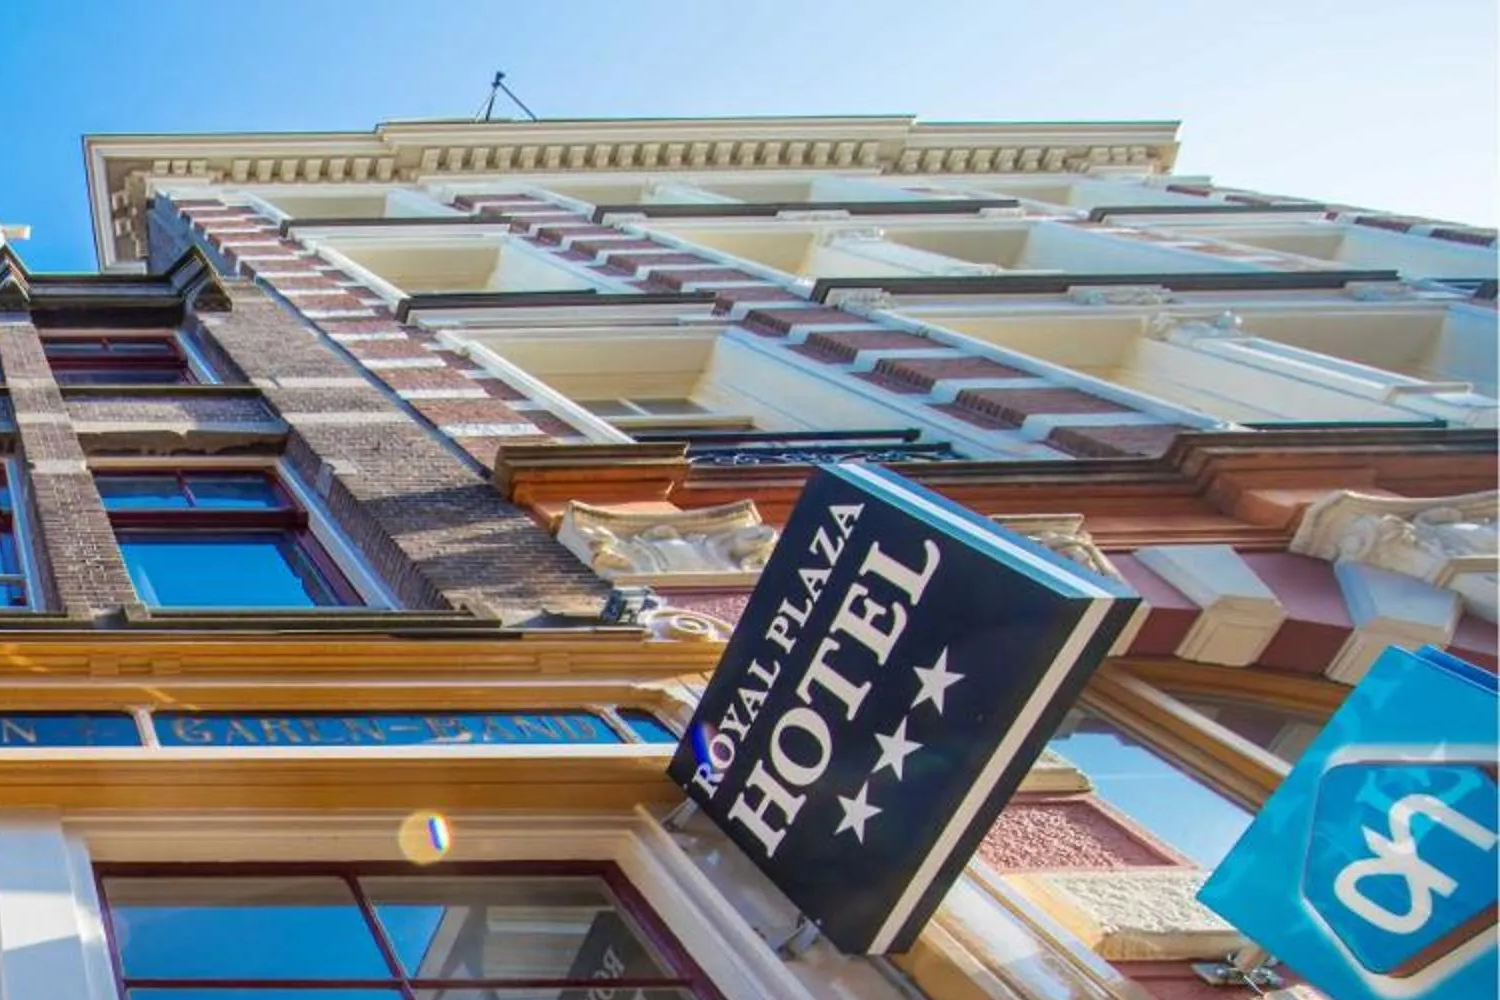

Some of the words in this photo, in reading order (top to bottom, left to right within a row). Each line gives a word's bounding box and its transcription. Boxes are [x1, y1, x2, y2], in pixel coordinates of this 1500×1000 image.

[692, 657, 781, 799] ROYAL
[765, 502, 865, 654] PLAZA
[727, 538, 941, 859] HOTEL
